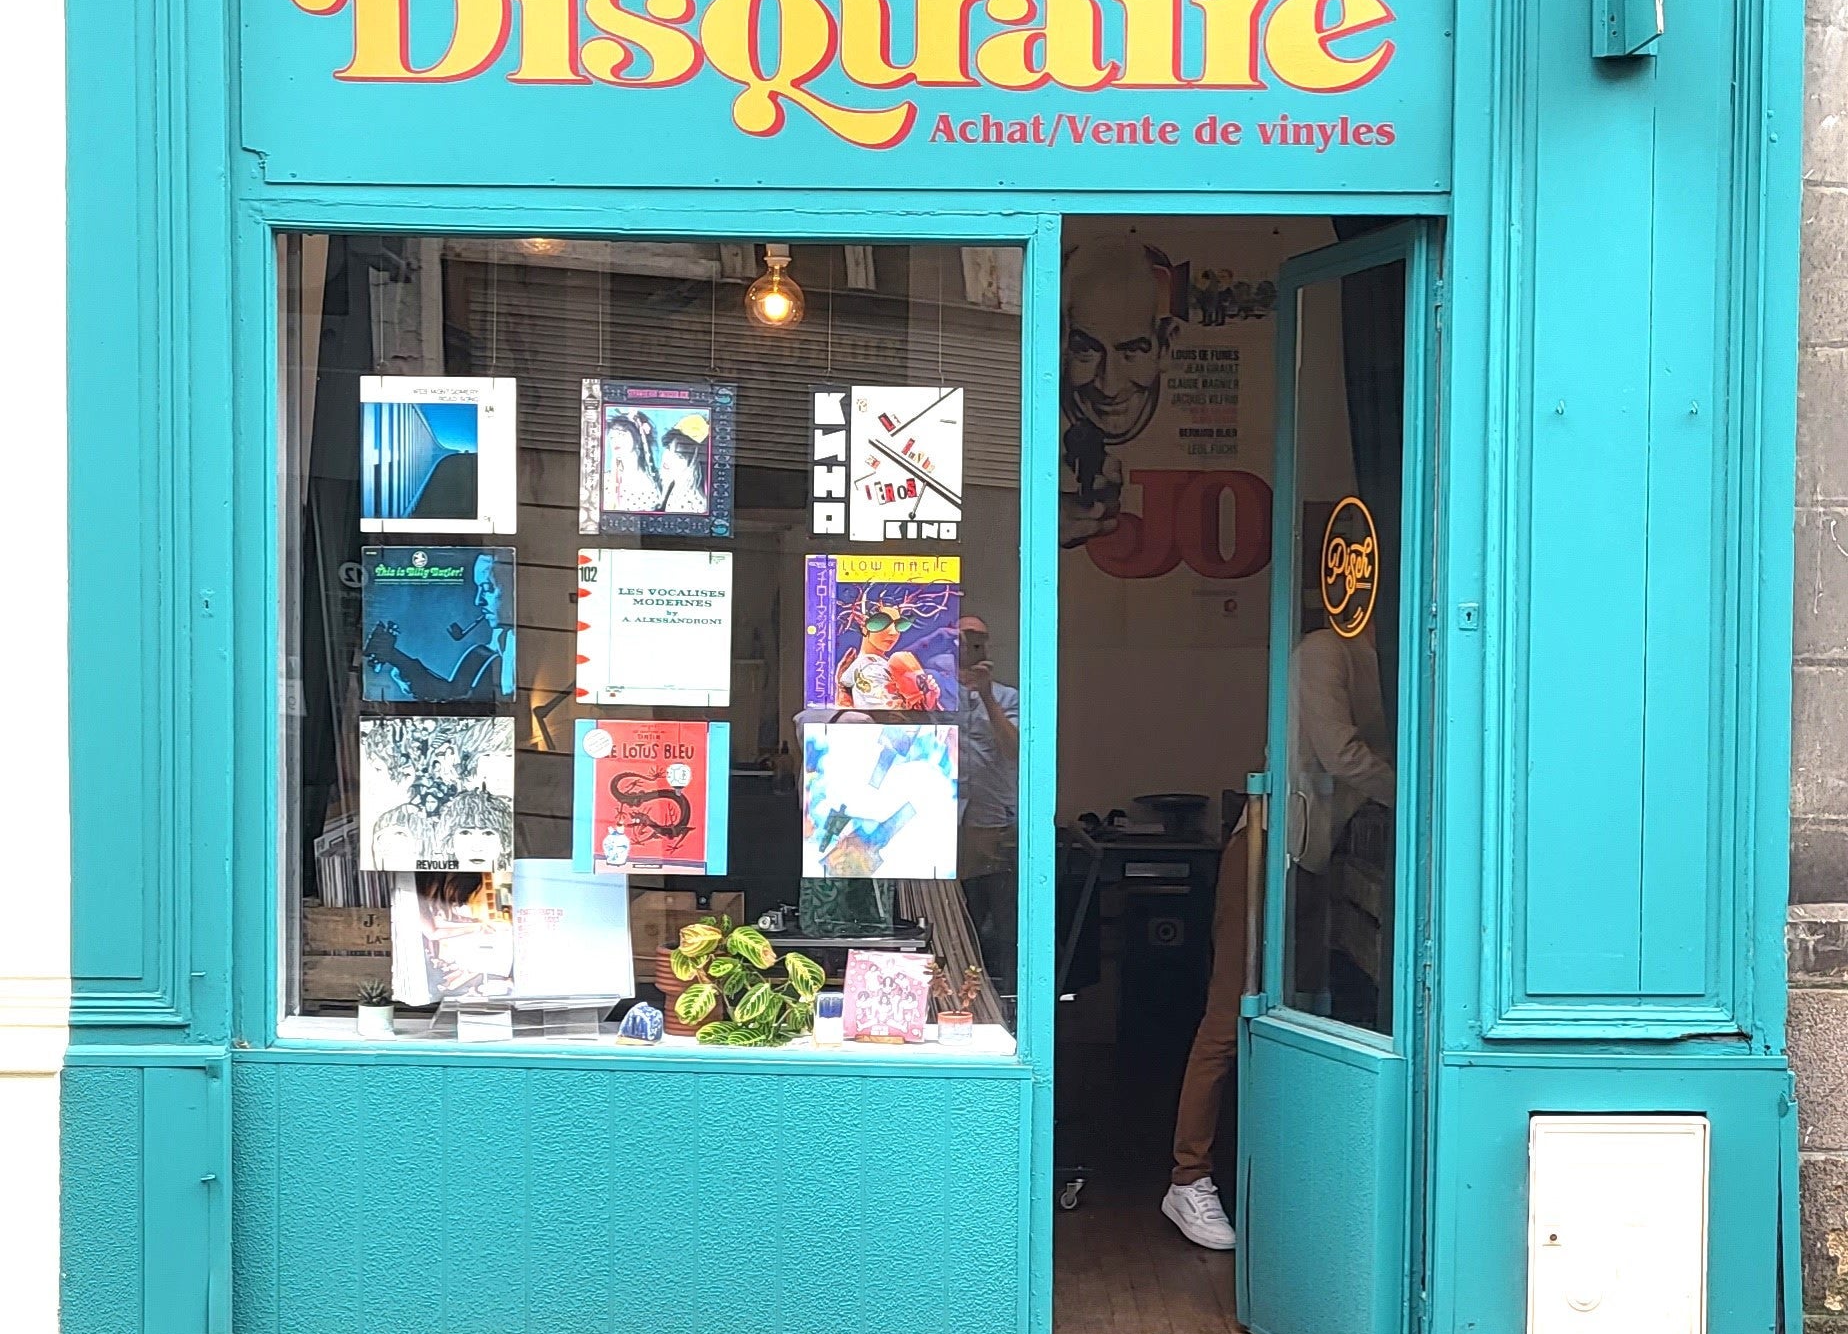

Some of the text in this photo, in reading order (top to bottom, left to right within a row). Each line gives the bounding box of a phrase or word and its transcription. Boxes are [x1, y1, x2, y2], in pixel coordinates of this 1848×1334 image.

[928, 112, 1396, 153] Achat/Vente de vinyles
[1085, 470, 1273, 579] JO
[375, 563, 396, 577] This
[406, 567, 430, 579] Billy
[579, 566, 597, 582] 102
[618, 588, 726, 598] LES VOCALISES
[633, 599, 713, 607] MODERNES
[622, 743, 658, 759] LOTUS
[664, 744, 694, 760] BLEU
[416, 859, 460, 870] REVOLVER
